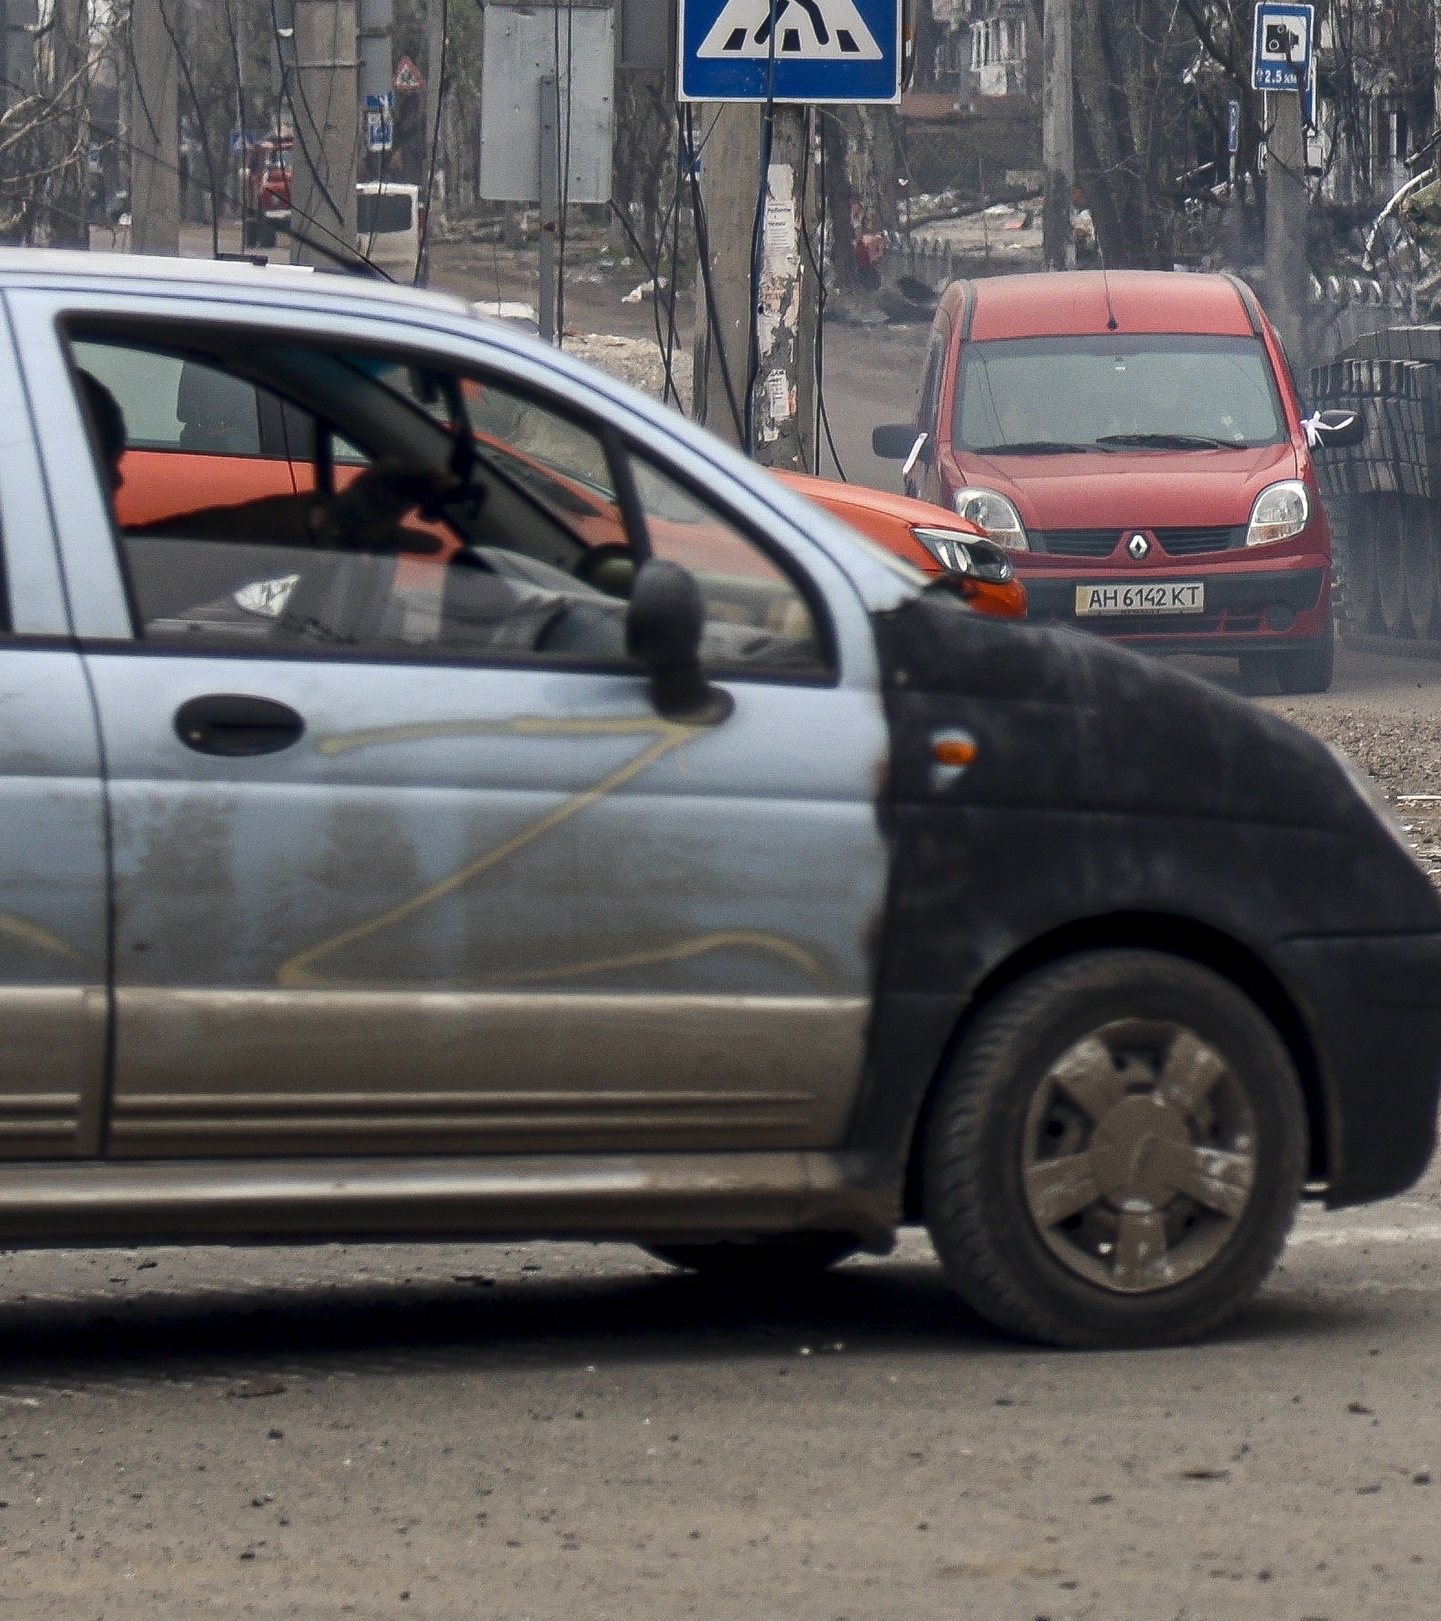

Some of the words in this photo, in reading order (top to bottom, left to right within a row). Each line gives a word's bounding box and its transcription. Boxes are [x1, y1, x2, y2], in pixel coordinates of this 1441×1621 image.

[1265, 69, 1282, 83] 2.5
[1089, 589, 1118, 608] AH
[1122, 588, 1167, 607] 6142
[1172, 586, 1200, 606] KT
